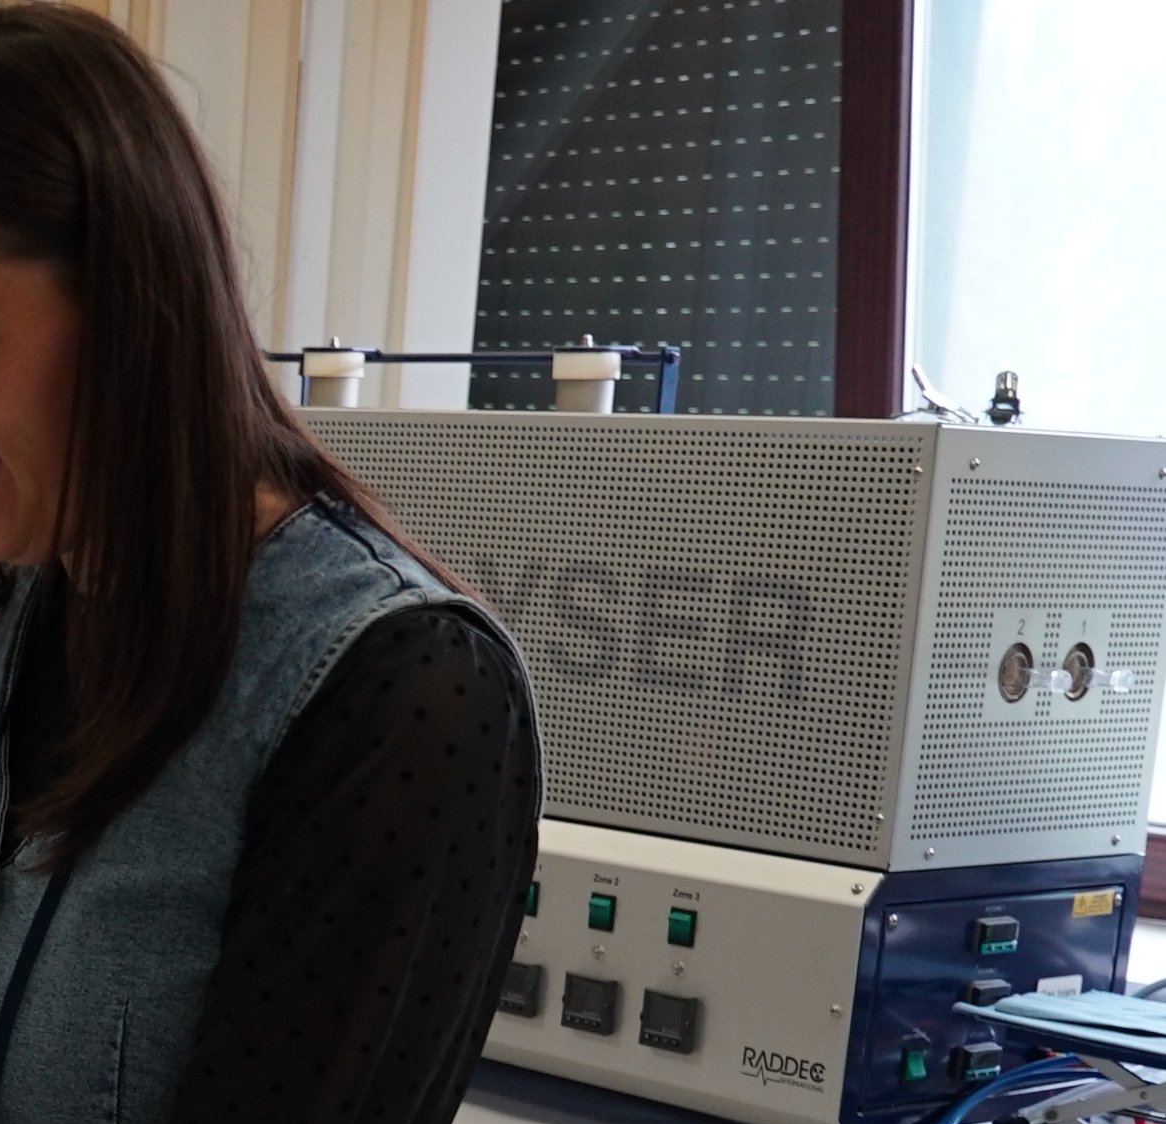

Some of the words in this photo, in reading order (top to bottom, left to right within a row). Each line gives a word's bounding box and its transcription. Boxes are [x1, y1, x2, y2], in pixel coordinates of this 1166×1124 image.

[1017, 619, 1026, 636] 2
[1081, 620, 1087, 636] 1
[593, 873, 612, 884] Zone
[614, 877, 620, 887] 2
[672, 888, 694, 899] Zone
[695, 891, 701, 901] 3
[742, 1046, 826, 1083] RADDEC
